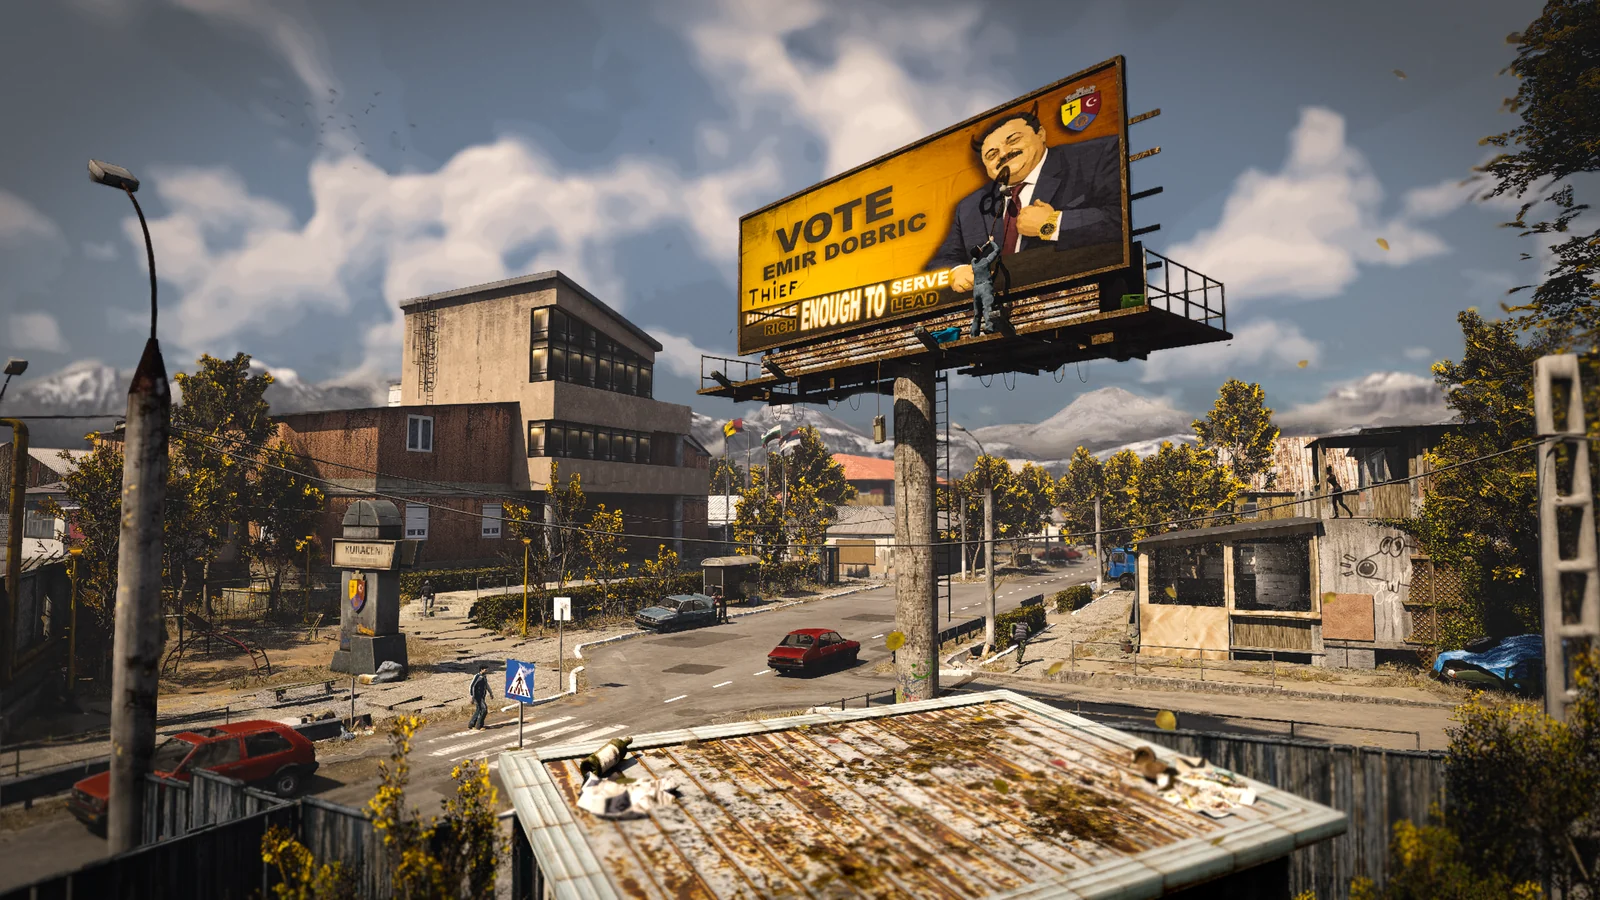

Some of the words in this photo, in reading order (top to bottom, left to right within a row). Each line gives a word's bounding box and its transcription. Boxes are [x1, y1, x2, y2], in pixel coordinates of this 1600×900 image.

[763, 250, 817, 281] EMIR
[825, 213, 927, 262] DOBRIC
[775, 185, 894, 253] VOTE
[764, 319, 797, 336] RICH
[800, 289, 861, 331] ENOUGH
[865, 283, 887, 319] TO
[891, 269, 950, 295] SERVE
[891, 291, 939, 312] LEAD
